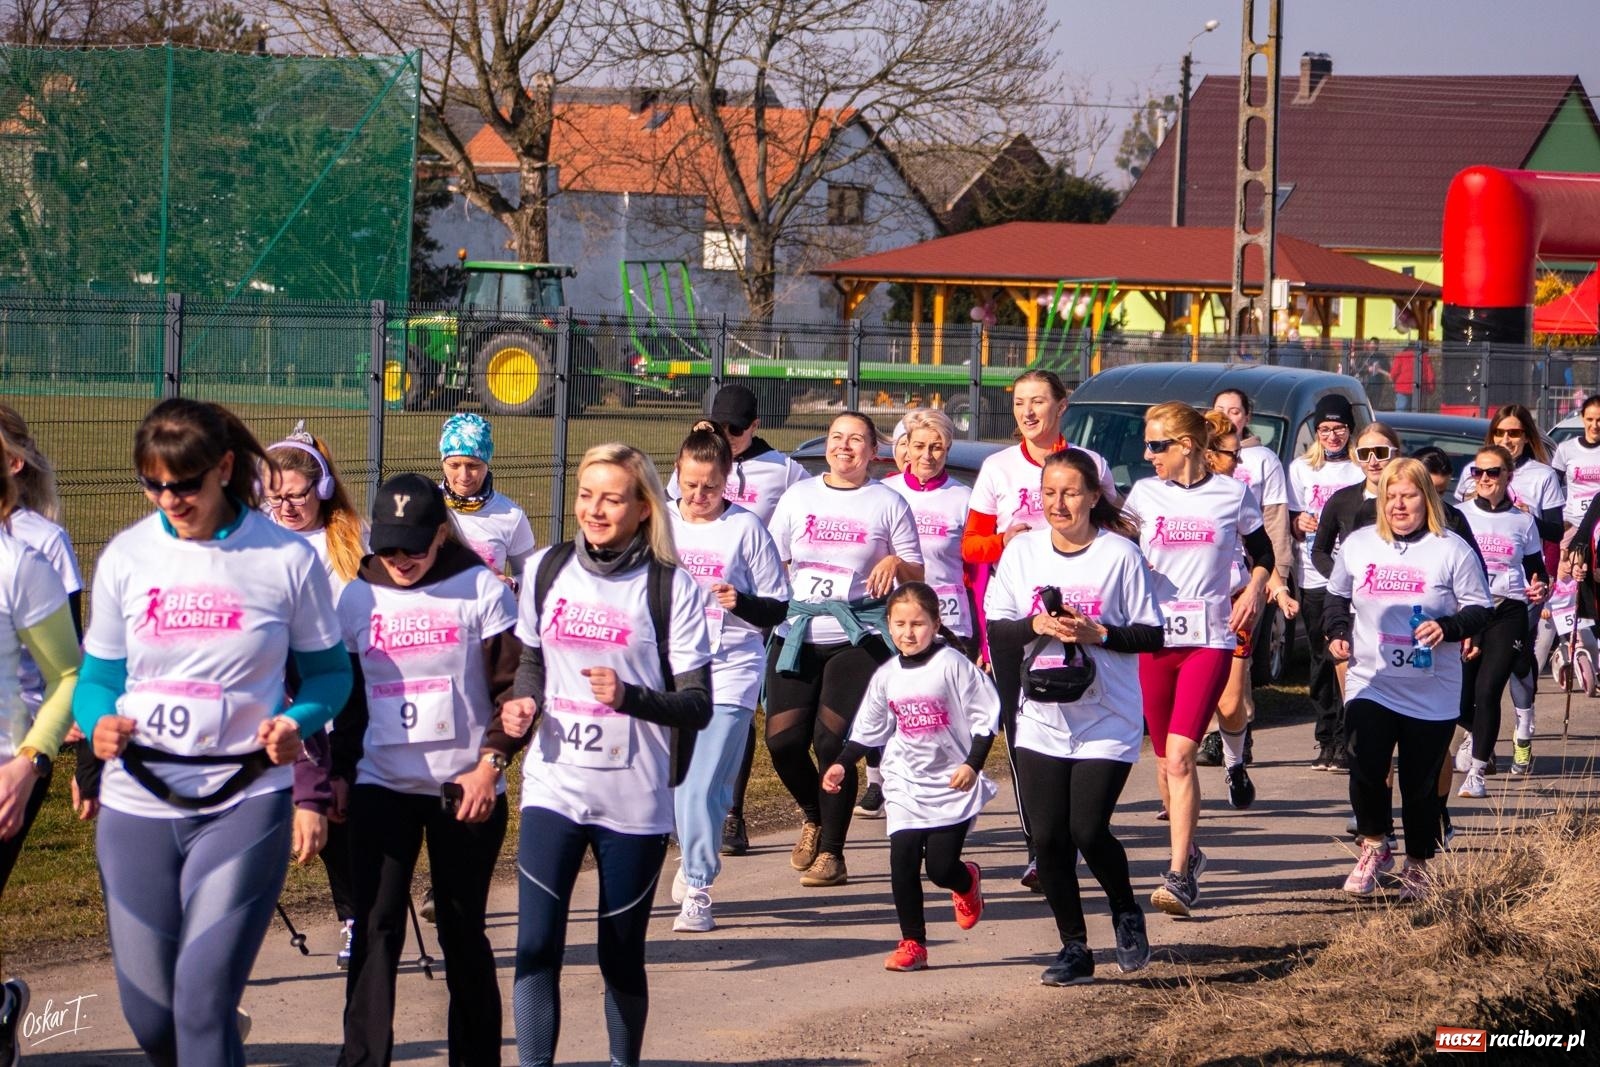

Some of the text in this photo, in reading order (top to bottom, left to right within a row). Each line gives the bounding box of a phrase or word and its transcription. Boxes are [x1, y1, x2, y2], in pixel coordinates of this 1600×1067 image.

[394, 494, 411, 517] Y
[817, 520, 849, 531] BIEG
[914, 514, 932, 525] EG
[1167, 520, 1198, 531] BIEG
[816, 530, 860, 542] KOBIET
[918, 525, 942, 535] BIET
[1169, 531, 1209, 541] KOBIET
[1477, 536, 1501, 546] BIEG
[680, 552, 705, 565] IEG
[688, 565, 715, 576] BIET
[1377, 569, 1408, 580] BIEG
[810, 576, 834, 598] 73
[1377, 580, 1419, 592] KOBIET
[164, 593, 214, 611] BIEG
[1061, 592, 1082, 603] EG
[939, 599, 960, 616] 22
[165, 611, 231, 628] KOBIET
[566, 606, 608, 625] BIEG
[387, 615, 431, 632] BIEG
[564, 620, 621, 642] KOBIET
[391, 629, 449, 647] KOBIET
[400, 702, 418, 730] 9
[899, 702, 929, 717] BIEG
[147, 703, 191, 738] 49
[904, 713, 943, 728] KOBIET
[567, 722, 603, 752] 42
